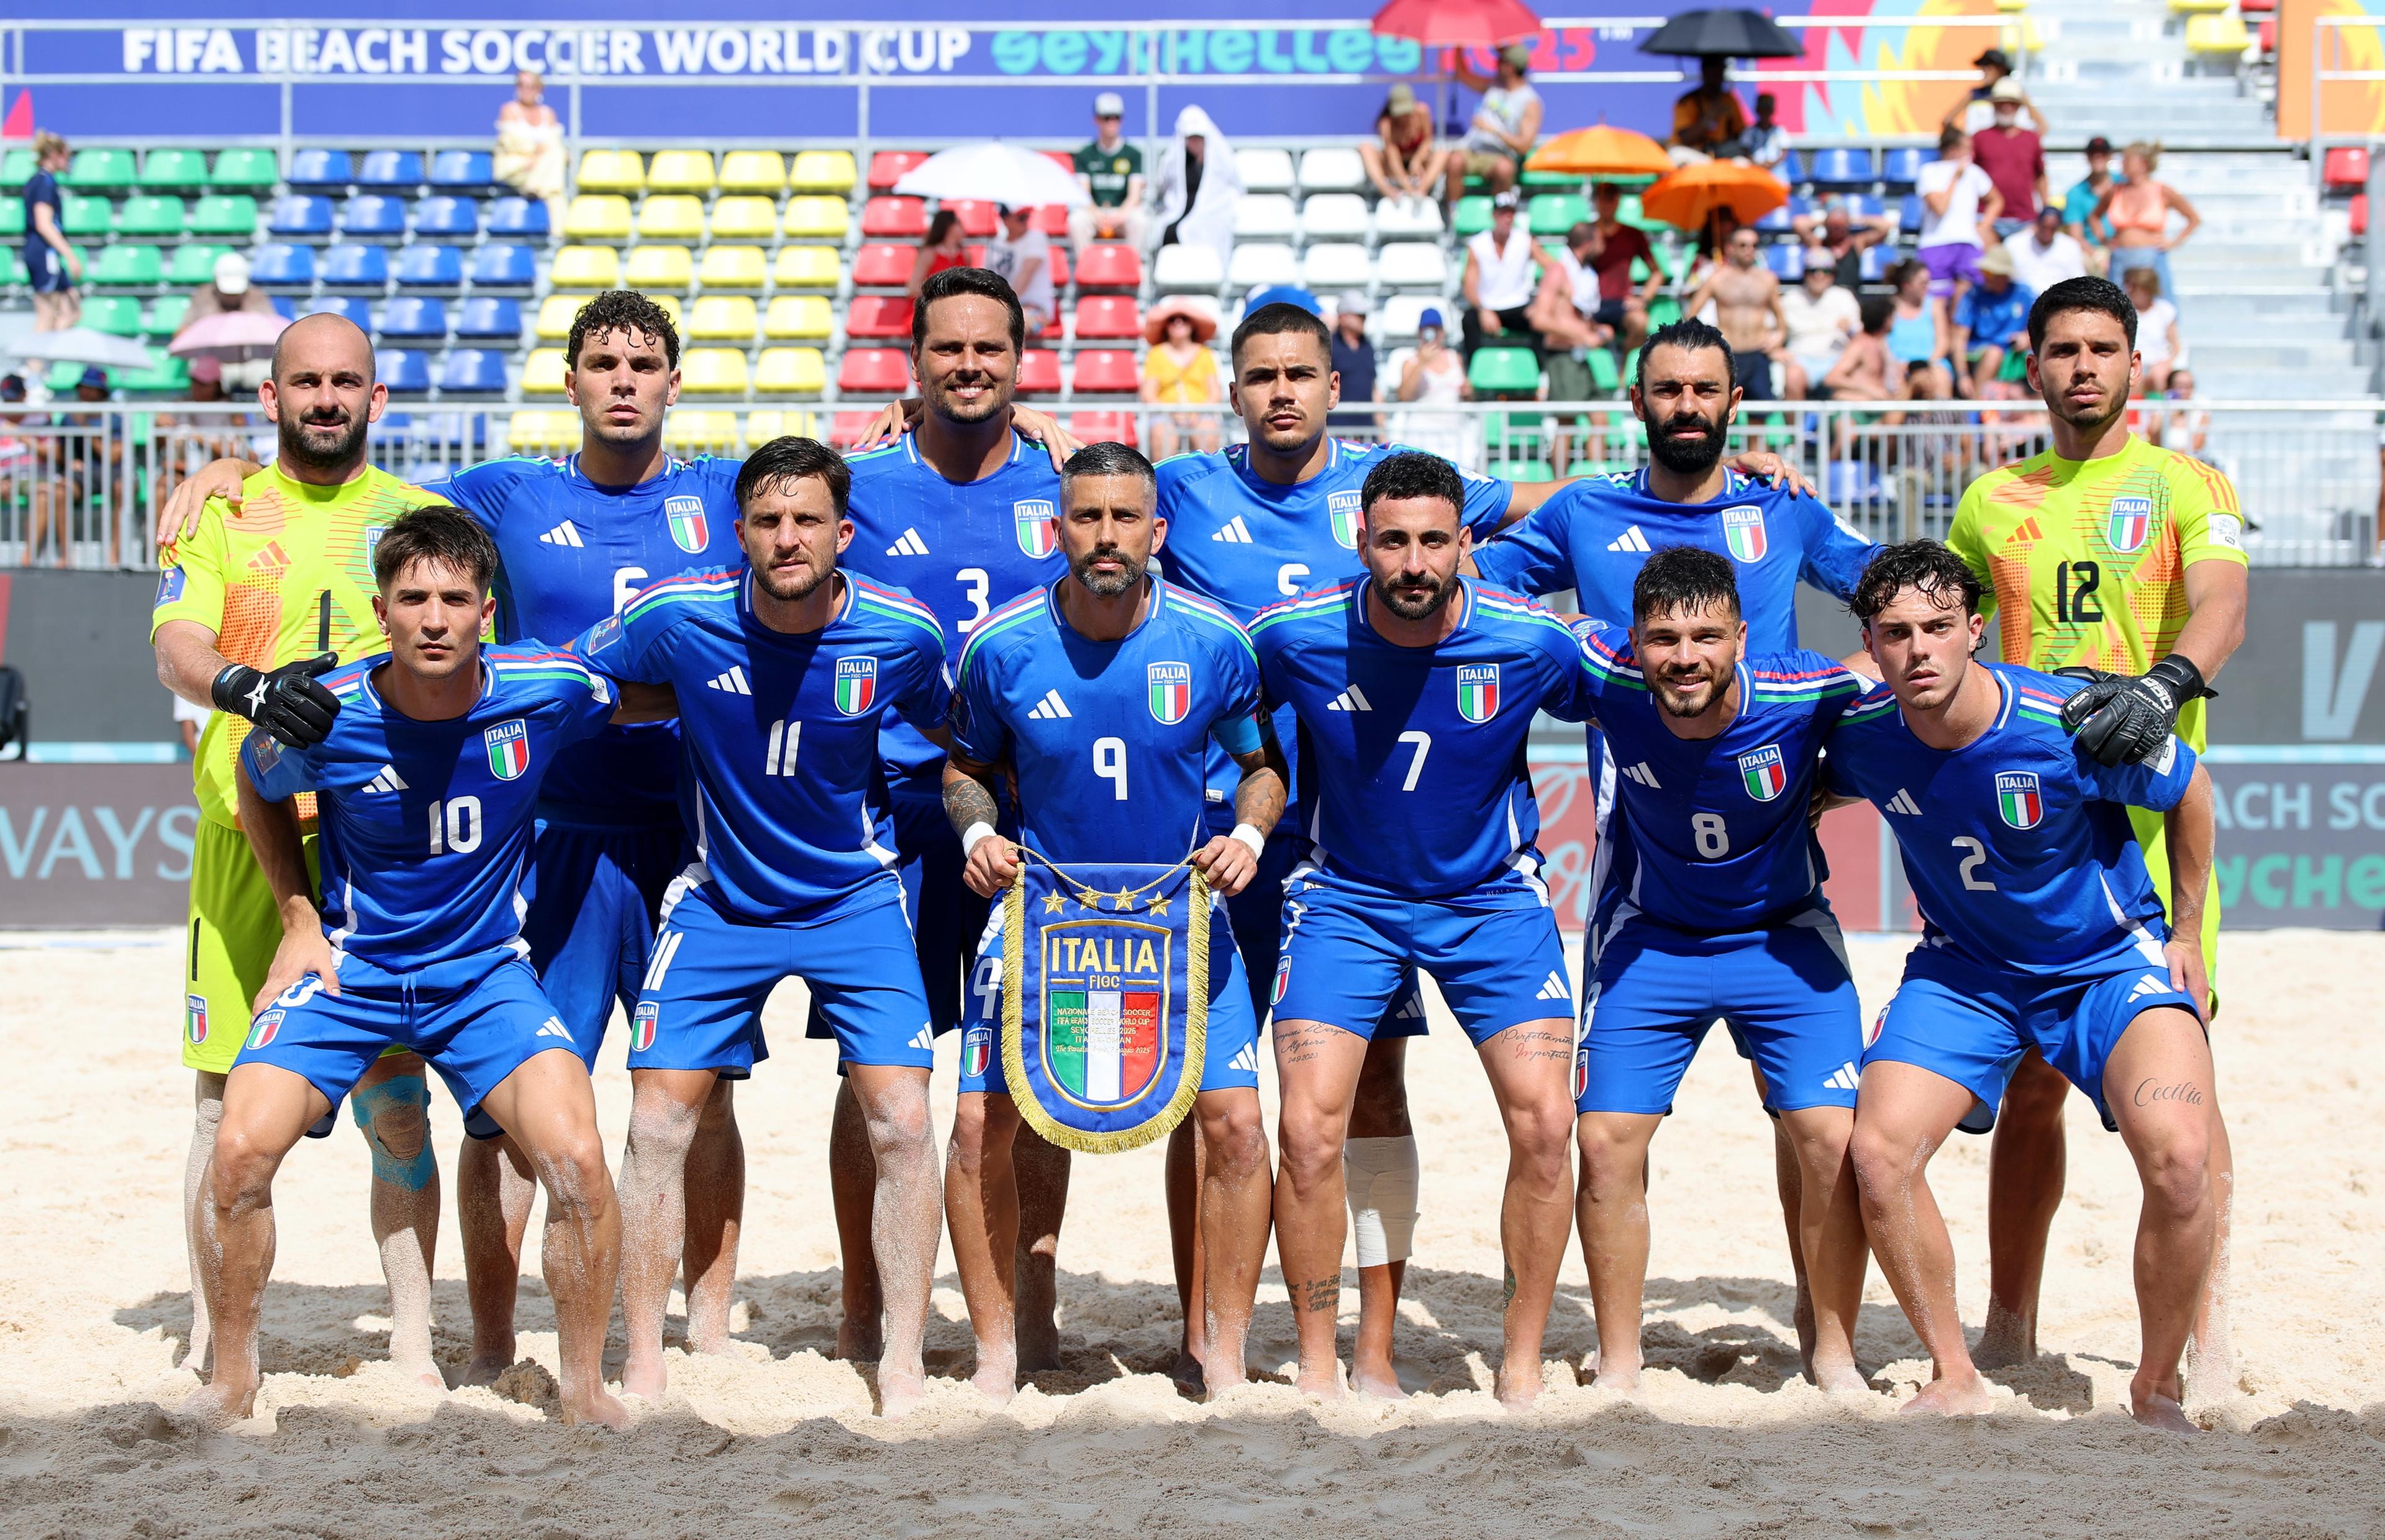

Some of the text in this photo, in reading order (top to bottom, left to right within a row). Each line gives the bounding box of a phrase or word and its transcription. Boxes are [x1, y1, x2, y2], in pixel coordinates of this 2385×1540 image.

[124, 29, 971, 74] FIFA BEACH SOCCER WORLD CUP
[668, 500, 700, 514] ITALIA
[1017, 504, 1050, 517] ITALIA
[1726, 510, 1759, 523] ITALIA
[2114, 500, 2147, 512] ITALIA
[955, 568, 990, 633] 3
[2057, 561, 2103, 622] 12
[318, 589, 331, 652] 1
[839, 661, 873, 674] ITALIA
[1151, 667, 1186, 680] ITALIA
[1461, 668, 1496, 681] ITALIA
[488, 723, 522, 743] ITALIA
[766, 719, 802, 777] 11
[1397, 730, 1432, 791] 7
[1742, 750, 1778, 768] ITALIA
[1093, 736, 1128, 800] 9
[1999, 777, 2035, 789] ITALIA
[429, 795, 481, 854] 10
[1691, 813, 1729, 859] 8
[1951, 836, 1997, 891] 2
[642, 930, 684, 992] 11
[1052, 938, 1158, 973] ITALIA
[973, 957, 1004, 1019] 9
[1089, 975, 1120, 989] FIGC
[1057, 1017, 1069, 1025] FIFA
[1138, 1018, 1150, 1026] CUP
[968, 1032, 989, 1044] ITALIA
[1516, 1043, 1570, 1061] Imperfetto
[2135, 1077, 2204, 1107] Cecilia
